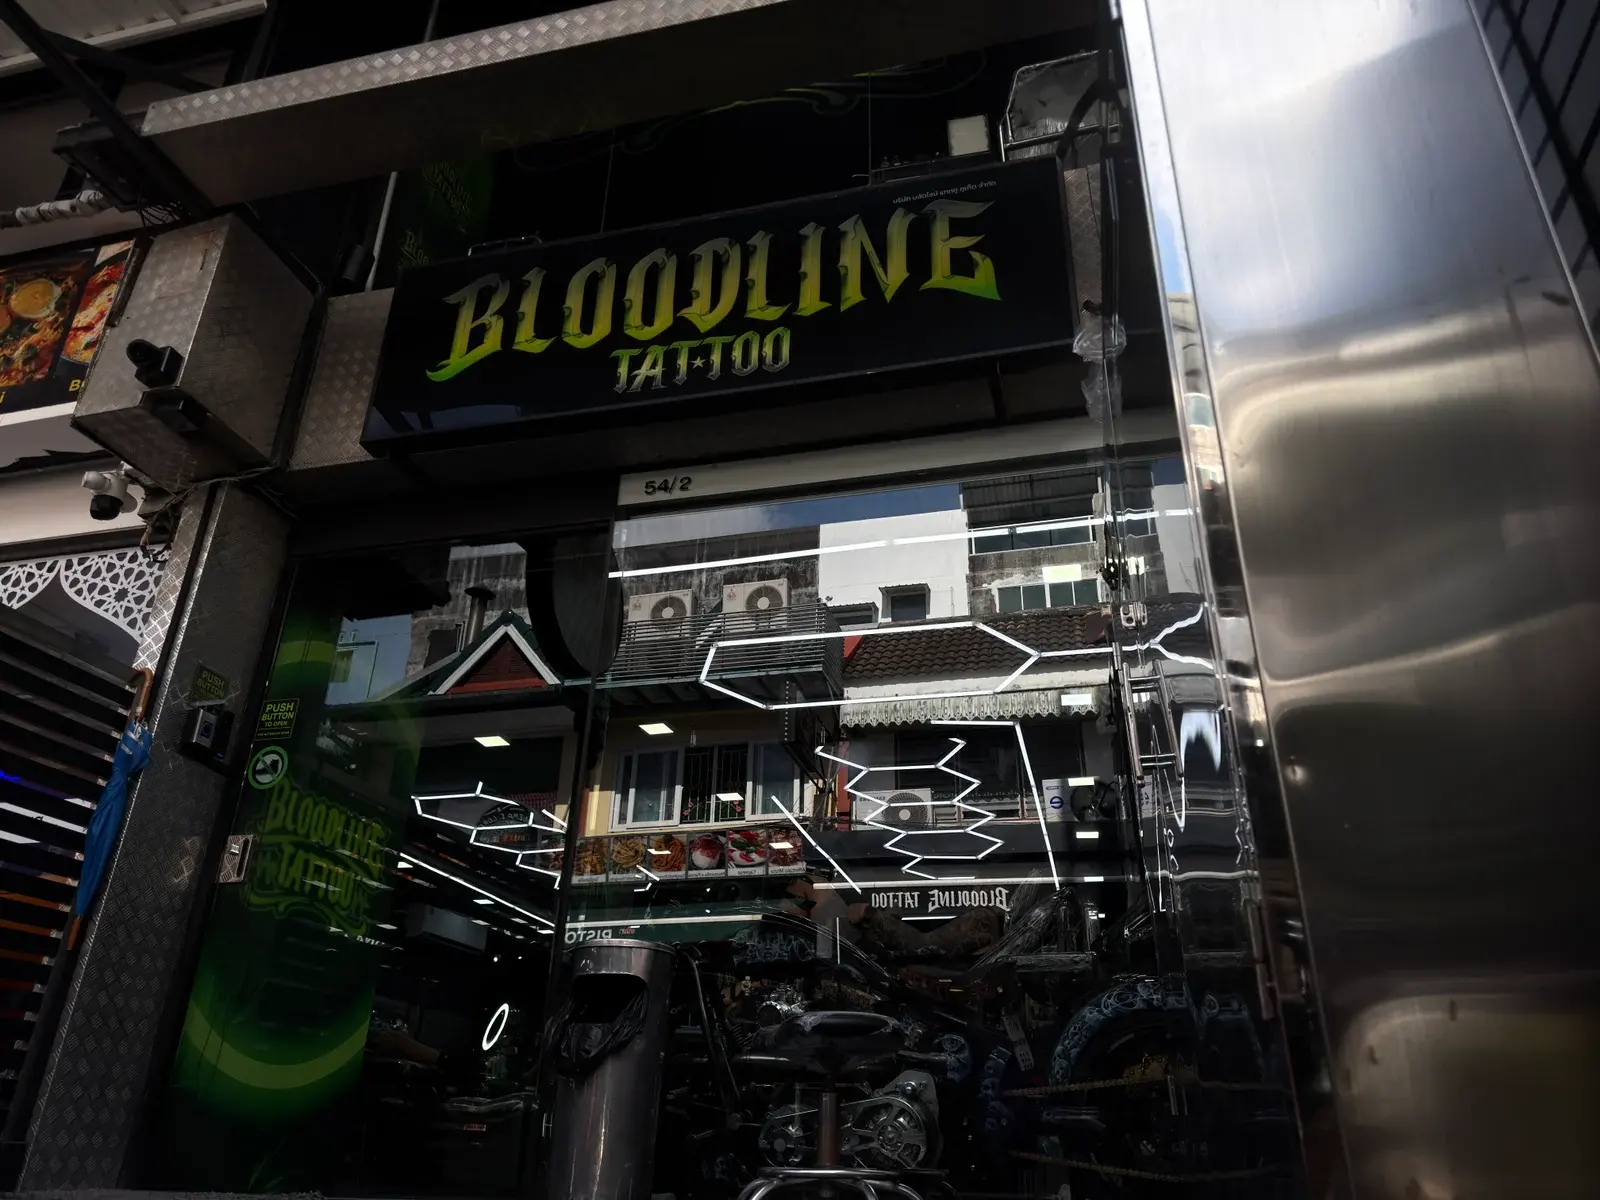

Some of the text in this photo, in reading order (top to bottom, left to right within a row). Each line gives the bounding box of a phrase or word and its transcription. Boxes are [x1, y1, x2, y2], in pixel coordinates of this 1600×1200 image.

[425, 198, 1002, 383] BLOODLINE
[609, 326, 791, 394] TATTOO
[644, 476, 692, 496] 54/2
[202, 670, 225, 689] PUSH
[261, 711, 295, 722] BUTTON
[265, 702, 295, 713] PUSH
